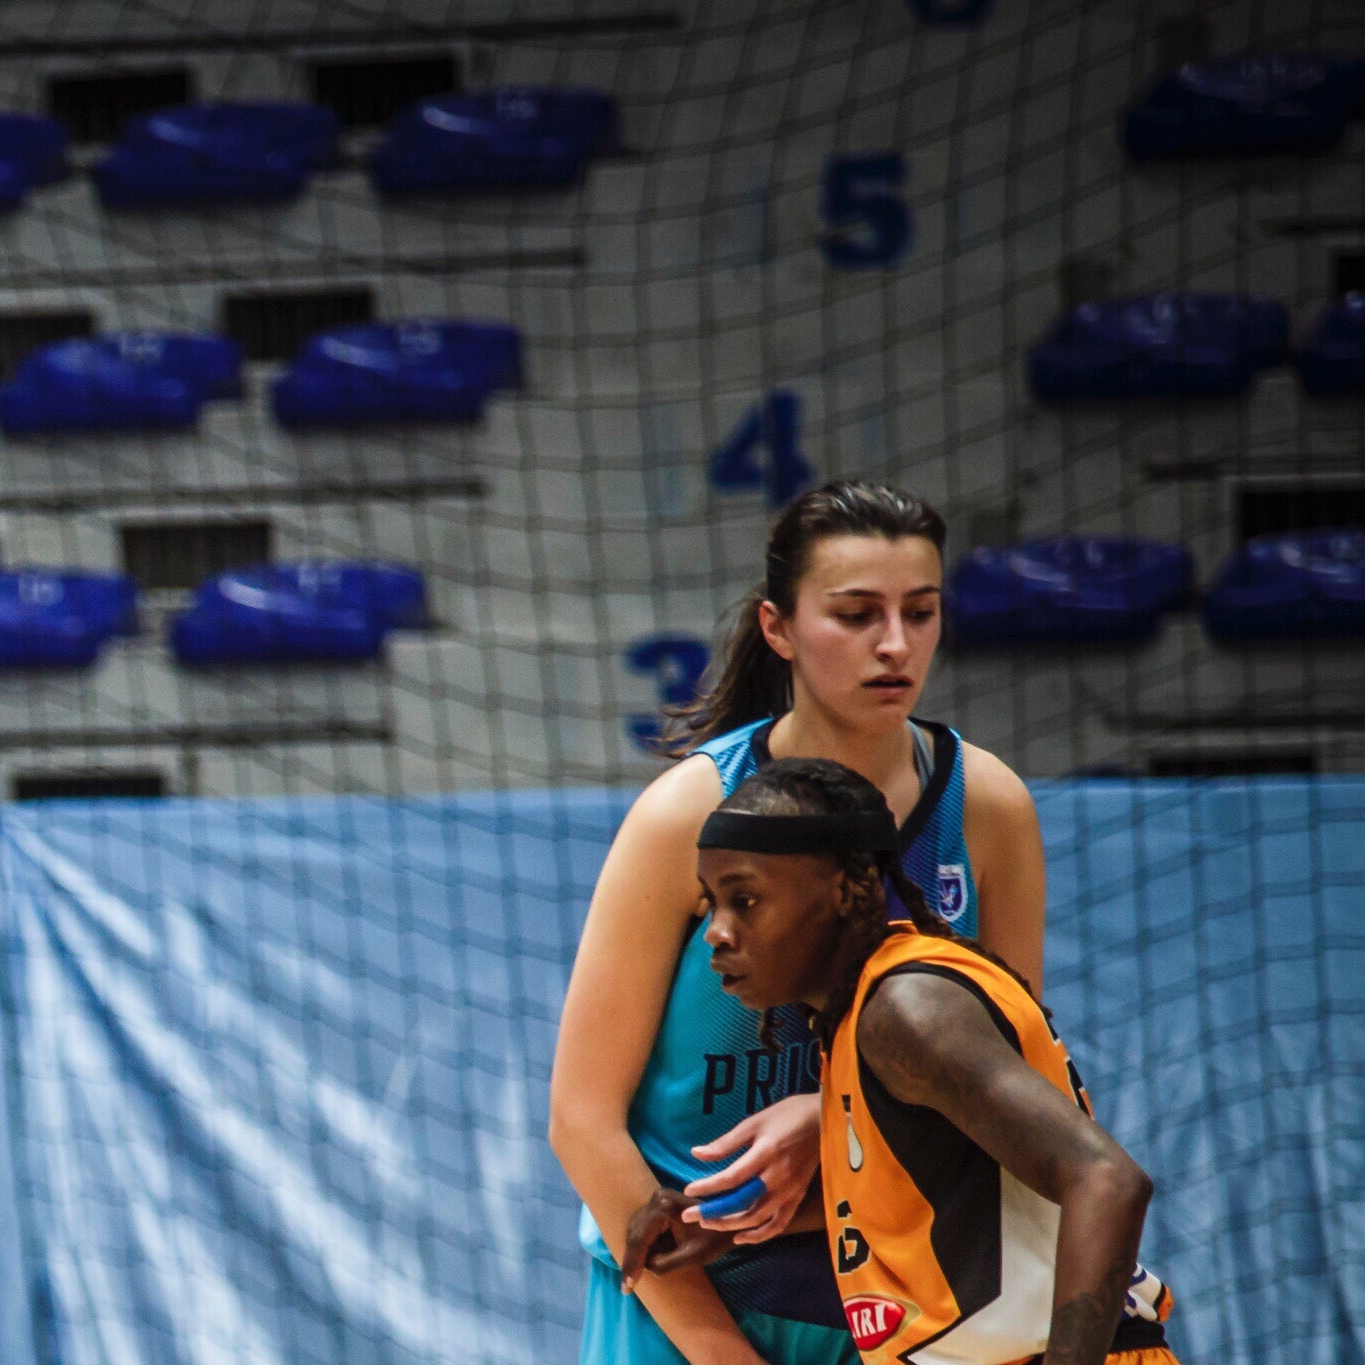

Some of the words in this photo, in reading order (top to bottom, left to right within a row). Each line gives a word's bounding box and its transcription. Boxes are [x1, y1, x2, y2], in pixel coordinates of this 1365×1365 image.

[820, 154, 911, 270] 5
[710, 388, 815, 506] 4
[626, 633, 711, 752] 3
[851, 1303, 887, 1339] IRI
